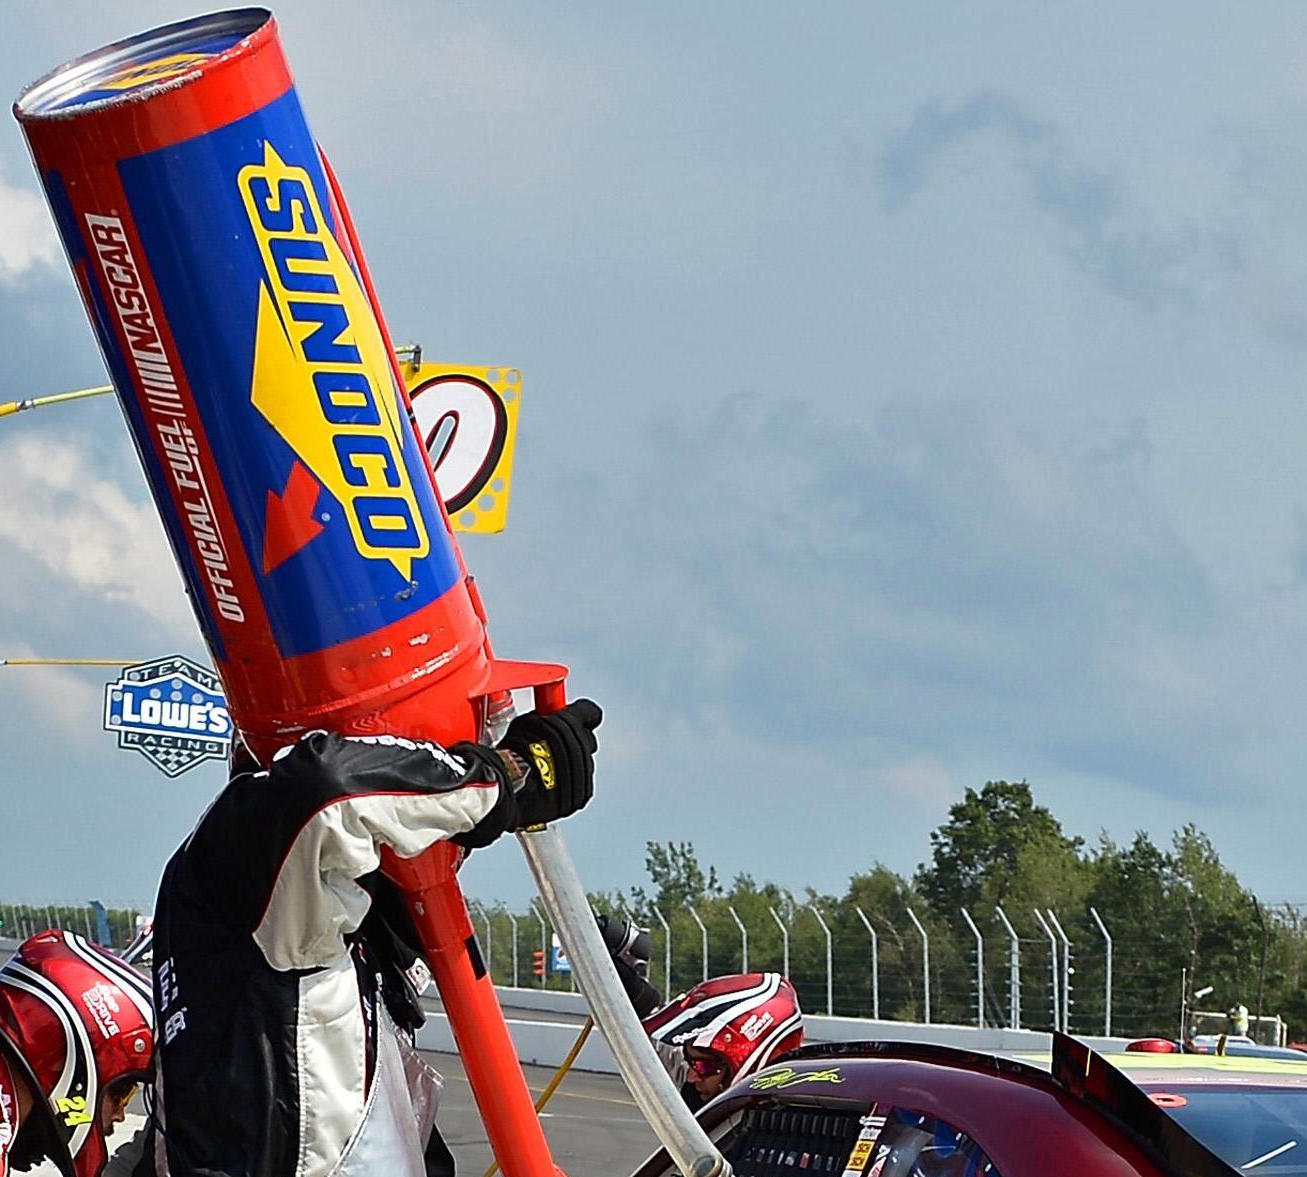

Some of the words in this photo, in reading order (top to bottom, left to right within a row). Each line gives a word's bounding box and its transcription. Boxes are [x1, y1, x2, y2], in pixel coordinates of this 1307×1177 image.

[88, 215, 166, 353] NASCAR
[248, 177, 421, 548] SUNOCO
[157, 418, 202, 492] FUEL
[180, 420, 200, 454] OF
[178, 497, 245, 623] OFFICIAL
[141, 664, 212, 687] TEAM
[123, 692, 229, 733] LOWE'S
[127, 734, 218, 751] RACING
[56, 1095, 93, 1126] 24
